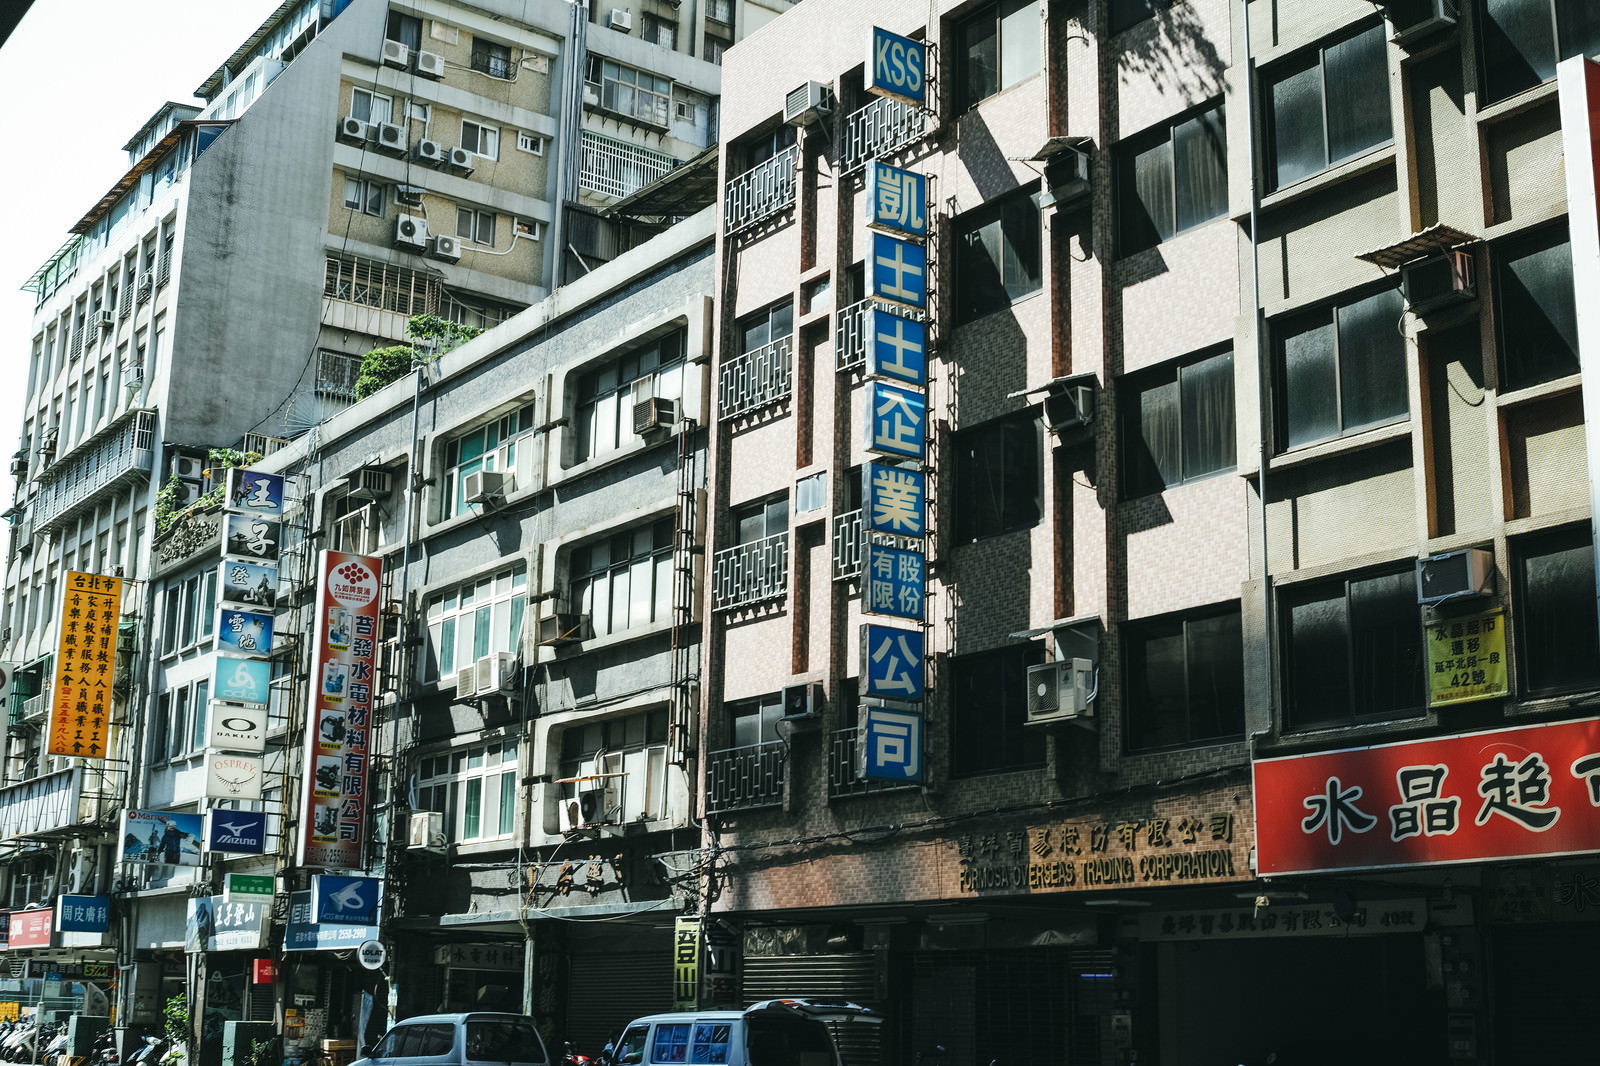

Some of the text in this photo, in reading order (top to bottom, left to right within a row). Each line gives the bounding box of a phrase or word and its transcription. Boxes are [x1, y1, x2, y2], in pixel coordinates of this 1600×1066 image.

[876, 38, 921, 92] KSS
[74, 575, 116, 592] 台北市
[60, 593, 83, 687] 音樂業職業工會
[70, 594, 99, 754] 家庭教學服務人員職業工會
[1434, 651, 1501, 674] 延平北路一段
[1451, 669, 1487, 688] 42號
[870, 633, 921, 778] 公司
[216, 732, 260, 740] OAKLEY
[213, 758, 257, 774] OSPREY
[959, 849, 1233, 893] FORMOSA OVERSEAS TRADING CORPORATION
[62, 904, 107, 923] 周皮膚科
